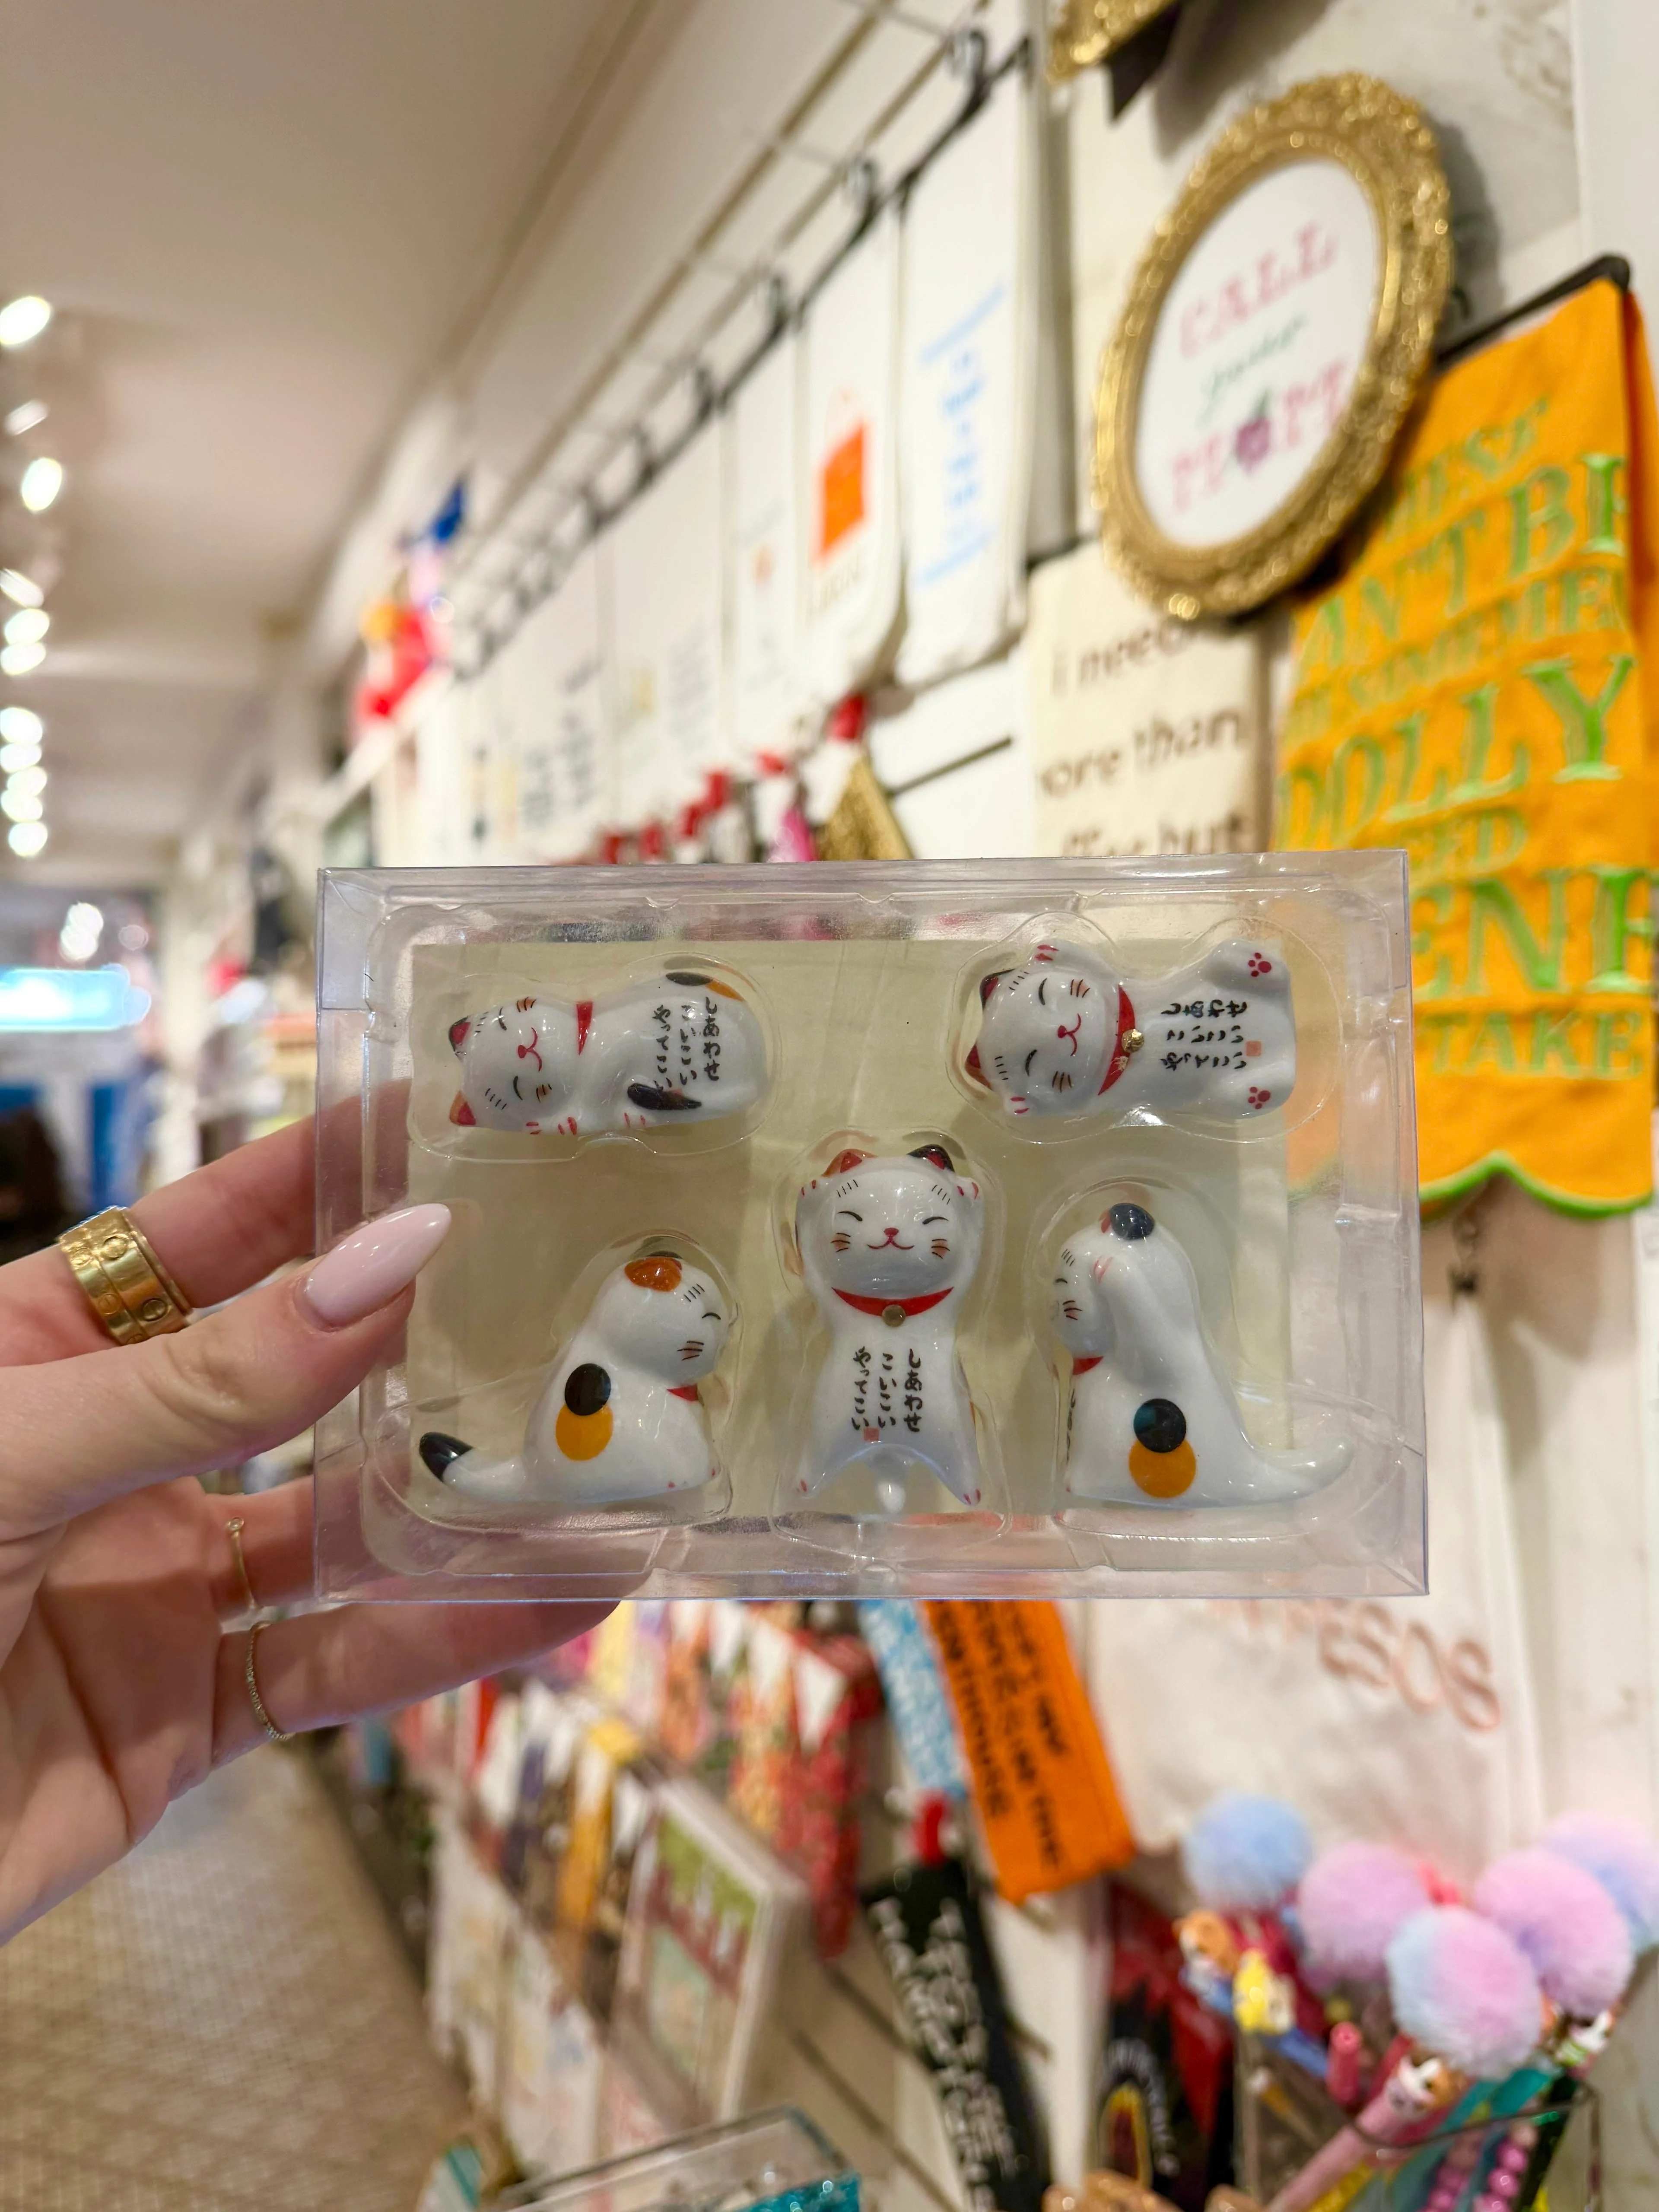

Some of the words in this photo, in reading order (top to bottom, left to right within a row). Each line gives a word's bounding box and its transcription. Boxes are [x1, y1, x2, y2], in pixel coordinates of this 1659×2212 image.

[1295, 508, 1486, 691] AN'T
[1039, 750, 1122, 798] ore
[1274, 653, 1638, 850] DOLLY
[703, 996, 721, 1081] しあわせ
[1161, 999, 1247, 1017] しあわせ
[1166, 1025, 1244, 1043] こいこい
[1421, 1009, 1642, 1079] TAKE
[1160, 1052, 1247, 1071] やってこい
[851, 1346, 871, 1430] やってこい
[877, 1352, 896, 1428] こいこい
[903, 1348, 923, 1433] しあわせ
